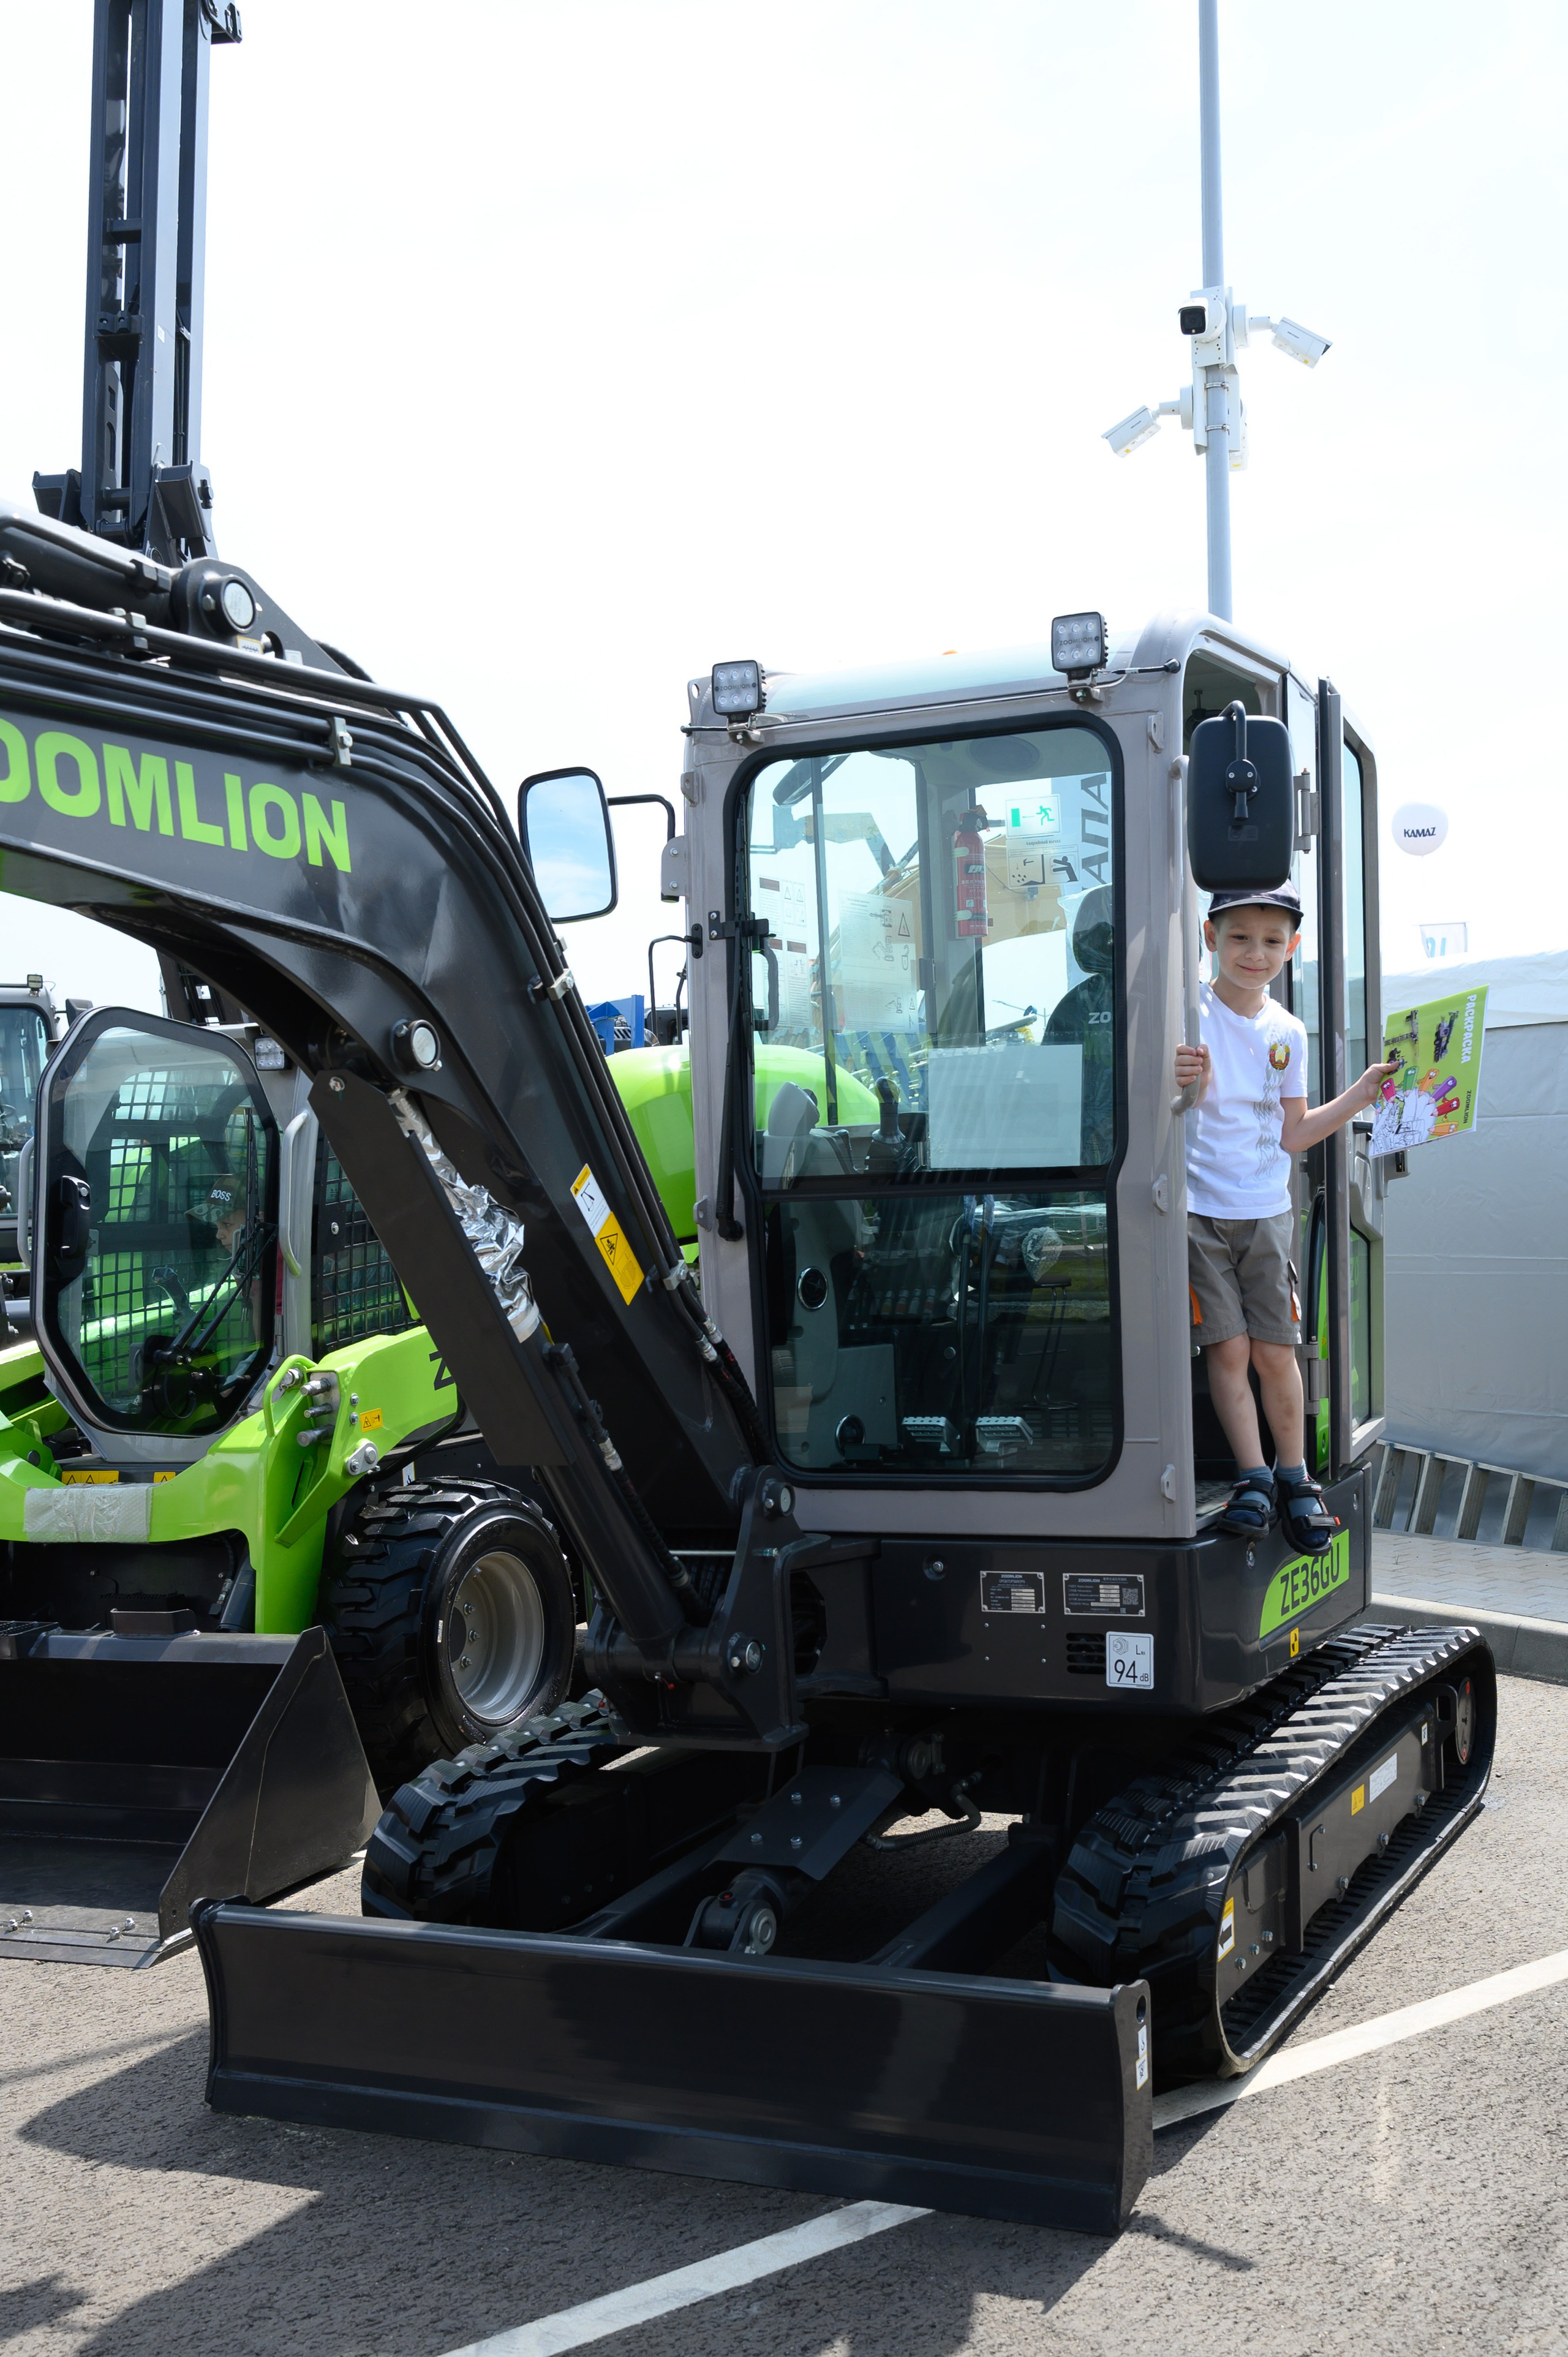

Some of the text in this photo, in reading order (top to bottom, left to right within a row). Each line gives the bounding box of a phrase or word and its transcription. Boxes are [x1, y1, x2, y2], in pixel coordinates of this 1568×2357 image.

[1059, 636, 1093, 646] ZOOMLION
[1404, 826, 1436, 838] KAMAZ
[1088, 1011, 1112, 1024] ZO
[1460, 994, 1477, 1064] РАСКРАСКА
[1463, 1090, 1472, 1124] ZOOMLION
[211, 1190, 231, 1201] BOSS
[1280, 1542, 1340, 1616] ZE36GU
[1114, 1659, 1149, 1683] 94 dB
